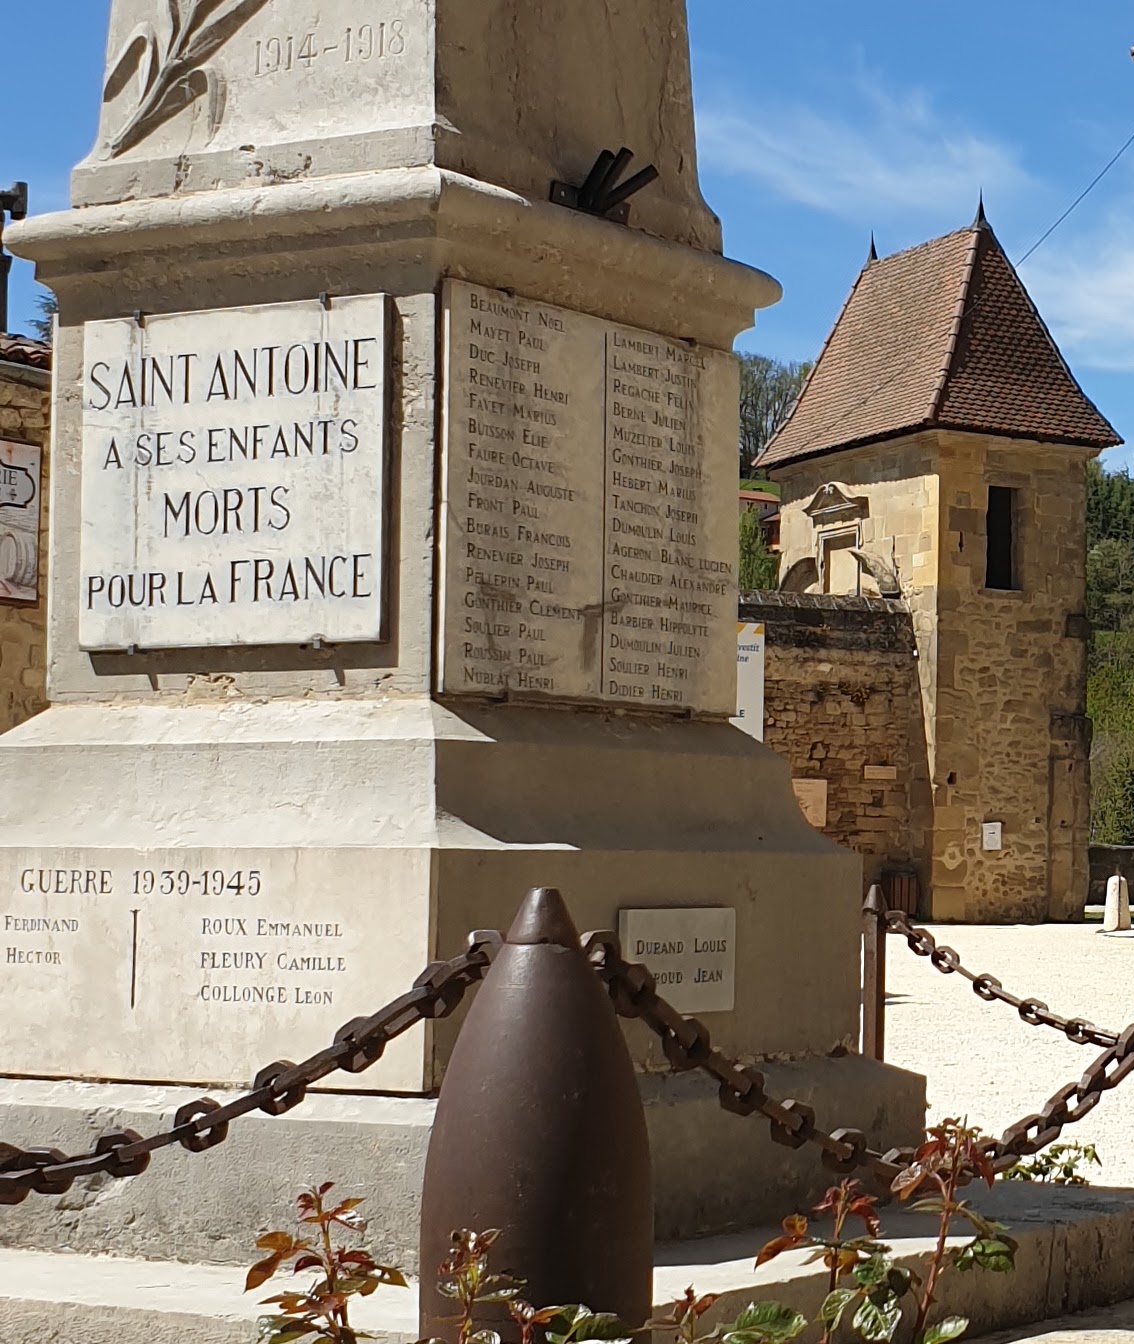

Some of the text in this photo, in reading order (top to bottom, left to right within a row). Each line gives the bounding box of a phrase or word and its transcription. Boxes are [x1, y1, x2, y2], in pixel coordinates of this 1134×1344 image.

[254, 19, 406, 76] 1914-1918
[470, 293, 565, 332] BEAUMONT NOEL
[470, 318, 545, 351] MAYET PAUL
[469, 343, 540, 374] DUC JOSEPH
[614, 332, 706, 370] LAMBERT MARCEL
[89, 338, 377, 411] SAINT ANTOINE
[469, 368, 568, 405] RENEVIER HENRI
[613, 355, 697, 389] LAMBERT JUSTIN
[613, 378, 660, 403] REGACHE
[469, 392, 557, 426] FAVET MARIUS
[653, 411, 686, 431] JULIEN
[103, 419, 359, 470] A SES ENFANTS
[468, 417, 549, 449] BUISSON ELIE
[670, 437, 696, 456] LOUIS
[468, 443, 555, 474] FAURE OCTAVE
[613, 448, 702, 480] GONTHIER JOSEPH
[0, 469, 17, 486] IE
[467, 466, 576, 502] JOURDAN AUGUSTE
[613, 471, 696, 501] HEBERT MARIUS
[163, 486, 291, 538] MORTS
[468, 492, 540, 519] FRONT PAUL
[612, 495, 698, 524] TANCHON JOSEPH
[467, 517, 571, 548] BURAIS FRANCOIS
[613, 518, 696, 546] DUMOULIN LOUIS
[467, 542, 570, 573] RENEVIER JOSEPH
[612, 542, 731, 573] AGERON BLANC LUCIEN
[87, 553, 372, 610] POUR LA FRANCE
[465, 566, 554, 594] PELLERIN PAUL
[611, 564, 727, 596] CHAUDIER ALEXANDRE
[465, 592, 581, 621] GONTHIER CLEMENT
[611, 587, 713, 616] GONTHIER MAURICE
[465, 617, 546, 641] SOULIER PAUL
[611, 611, 709, 637] BARBIER HIPPOLYTE
[519, 648, 546, 666] PAUL
[611, 634, 700, 658] DUMOULIN JULIEN
[464, 666, 554, 690] NUBLAT HENRI
[609, 657, 688, 680] SOULIER HENRI
[609, 680, 683, 702] DIDIER HENRI
[21, 869, 262, 896] GUERRE 1939-1945
[4, 915, 79, 933] FERDINAND
[201, 918, 343, 938] ROUX EMMANUEL
[5, 947, 62, 965] HECTOR
[636, 938, 727, 956] DURAND LOUIS
[200, 952, 347, 972] FLEURY CAMILLE
[694, 968, 723, 983] JEAN
[200, 985, 333, 1005] COLLONGE LEON
